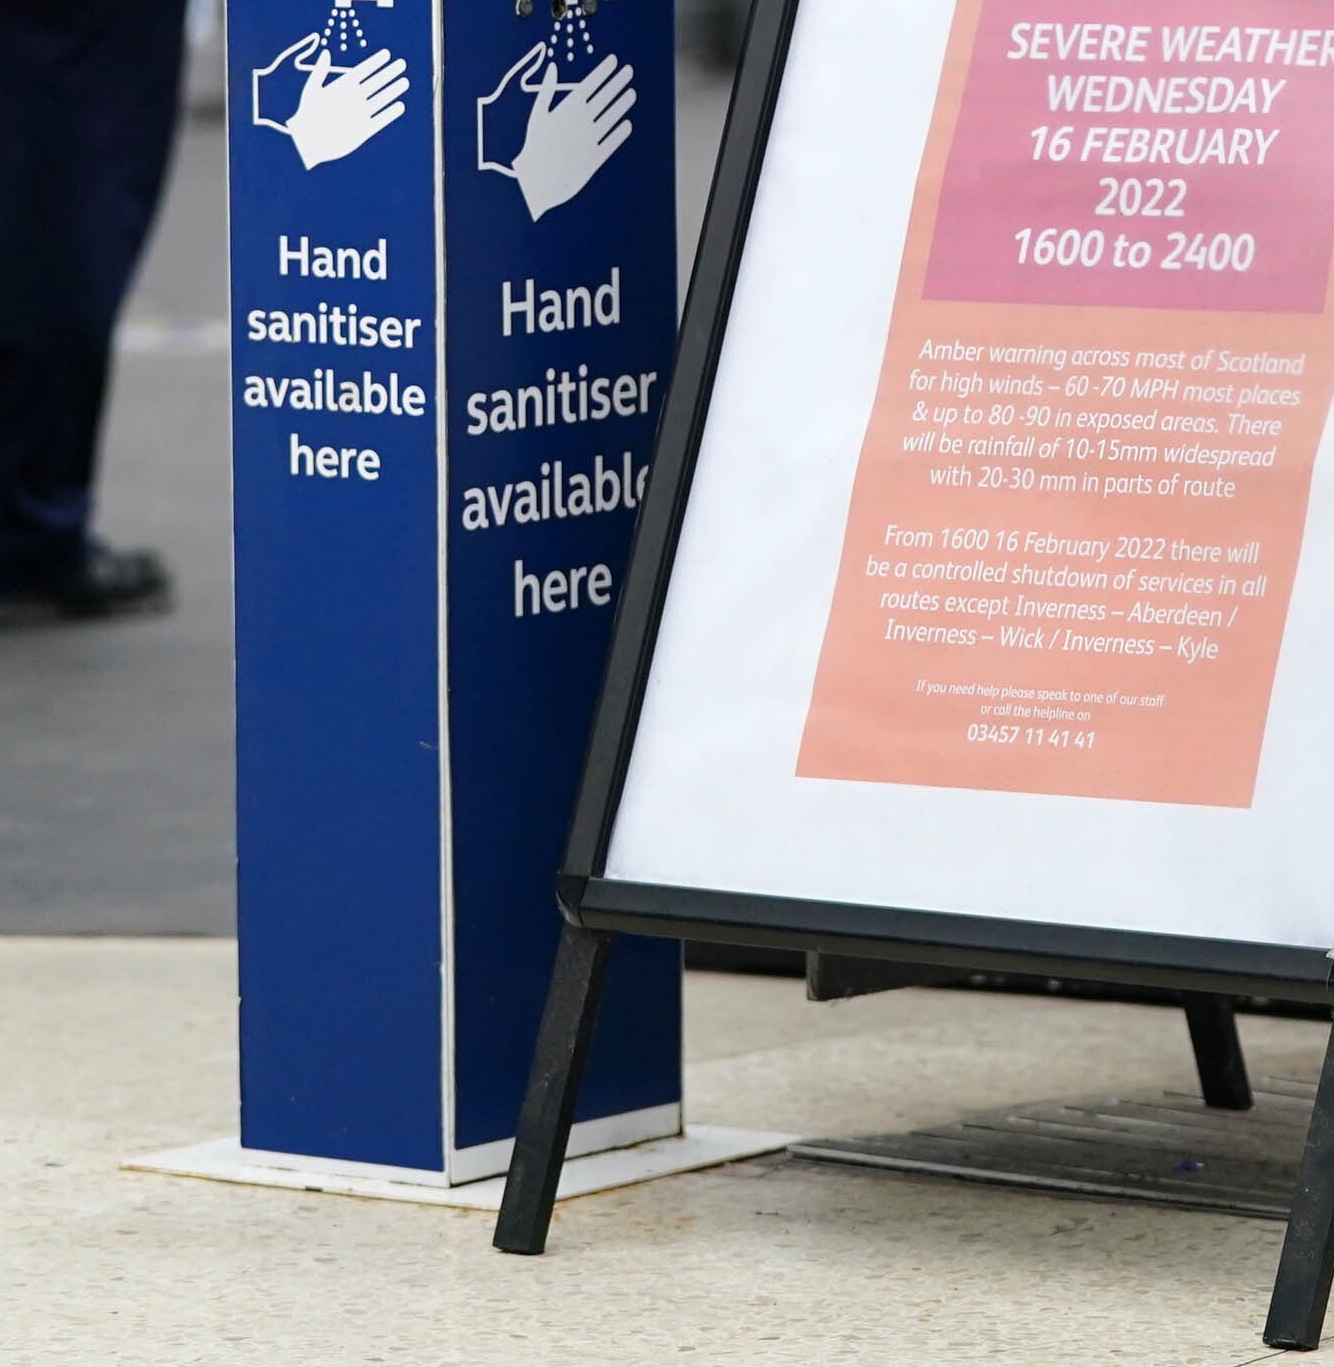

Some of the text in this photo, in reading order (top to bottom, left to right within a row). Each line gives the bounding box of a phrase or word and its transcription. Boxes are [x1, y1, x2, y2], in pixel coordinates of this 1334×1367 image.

[1007, 22, 1149, 62] SEVERE
[1046, 75, 1286, 113] WEDNESDAY
[1029, 125, 1279, 164] 16 FEBRUARY
[1095, 178, 1186, 216] 2022
[278, 234, 387, 280] Hand
[1014, 228, 1254, 270] 1600 to 2400
[502, 267, 620, 336] Hand
[248, 302, 421, 348] sanitiser
[919, 339, 1305, 374] Amber warning across most of Scotland
[243, 368, 426, 416] available
[467, 362, 657, 435] sanitiser
[909, 369, 935, 393] for
[940, 371, 982, 397] high
[989, 374, 1042, 395] winds
[1065, 375, 1088, 396] 60
[1130, 377, 1178, 399] MPH
[1183, 380, 1233, 402] most
[1237, 383, 1301, 407] places
[912, 401, 929, 421] &
[933, 406, 957, 426] up
[962, 405, 983, 423] to
[989, 404, 1014, 424] 80
[1056, 407, 1071, 426] in
[1076, 407, 1156, 433] exposed
[1161, 411, 1219, 432] areas.
[1227, 412, 1283, 435] There
[289, 433, 381, 480] here
[902, 432, 1277, 468] will be rainfall of 10-15mm widespread
[930, 464, 1235, 498] with 20-30 mm in parts of route
[885, 523, 1260, 563] From 1600 16 February 2022 there will
[514, 559, 612, 617] here
[865, 555, 1266, 597] be a controlled shutdown of services in all
[880, 590, 939, 611] routes
[944, 593, 1009, 617] except
[1014, 595, 1107, 620] Inverness
[1127, 601, 1222, 625] Aberdeen
[885, 619, 977, 645] Inverness
[999, 624, 1043, 649] Wick
[1063, 630, 1154, 655] Inverness
[1176, 634, 1219, 663] Kyle
[915, 678, 1166, 706] If you need help please speak to one of our staff
[980, 704, 1090, 720] or call the helpline on
[967, 723, 1095, 748] 03457 11 41 41
